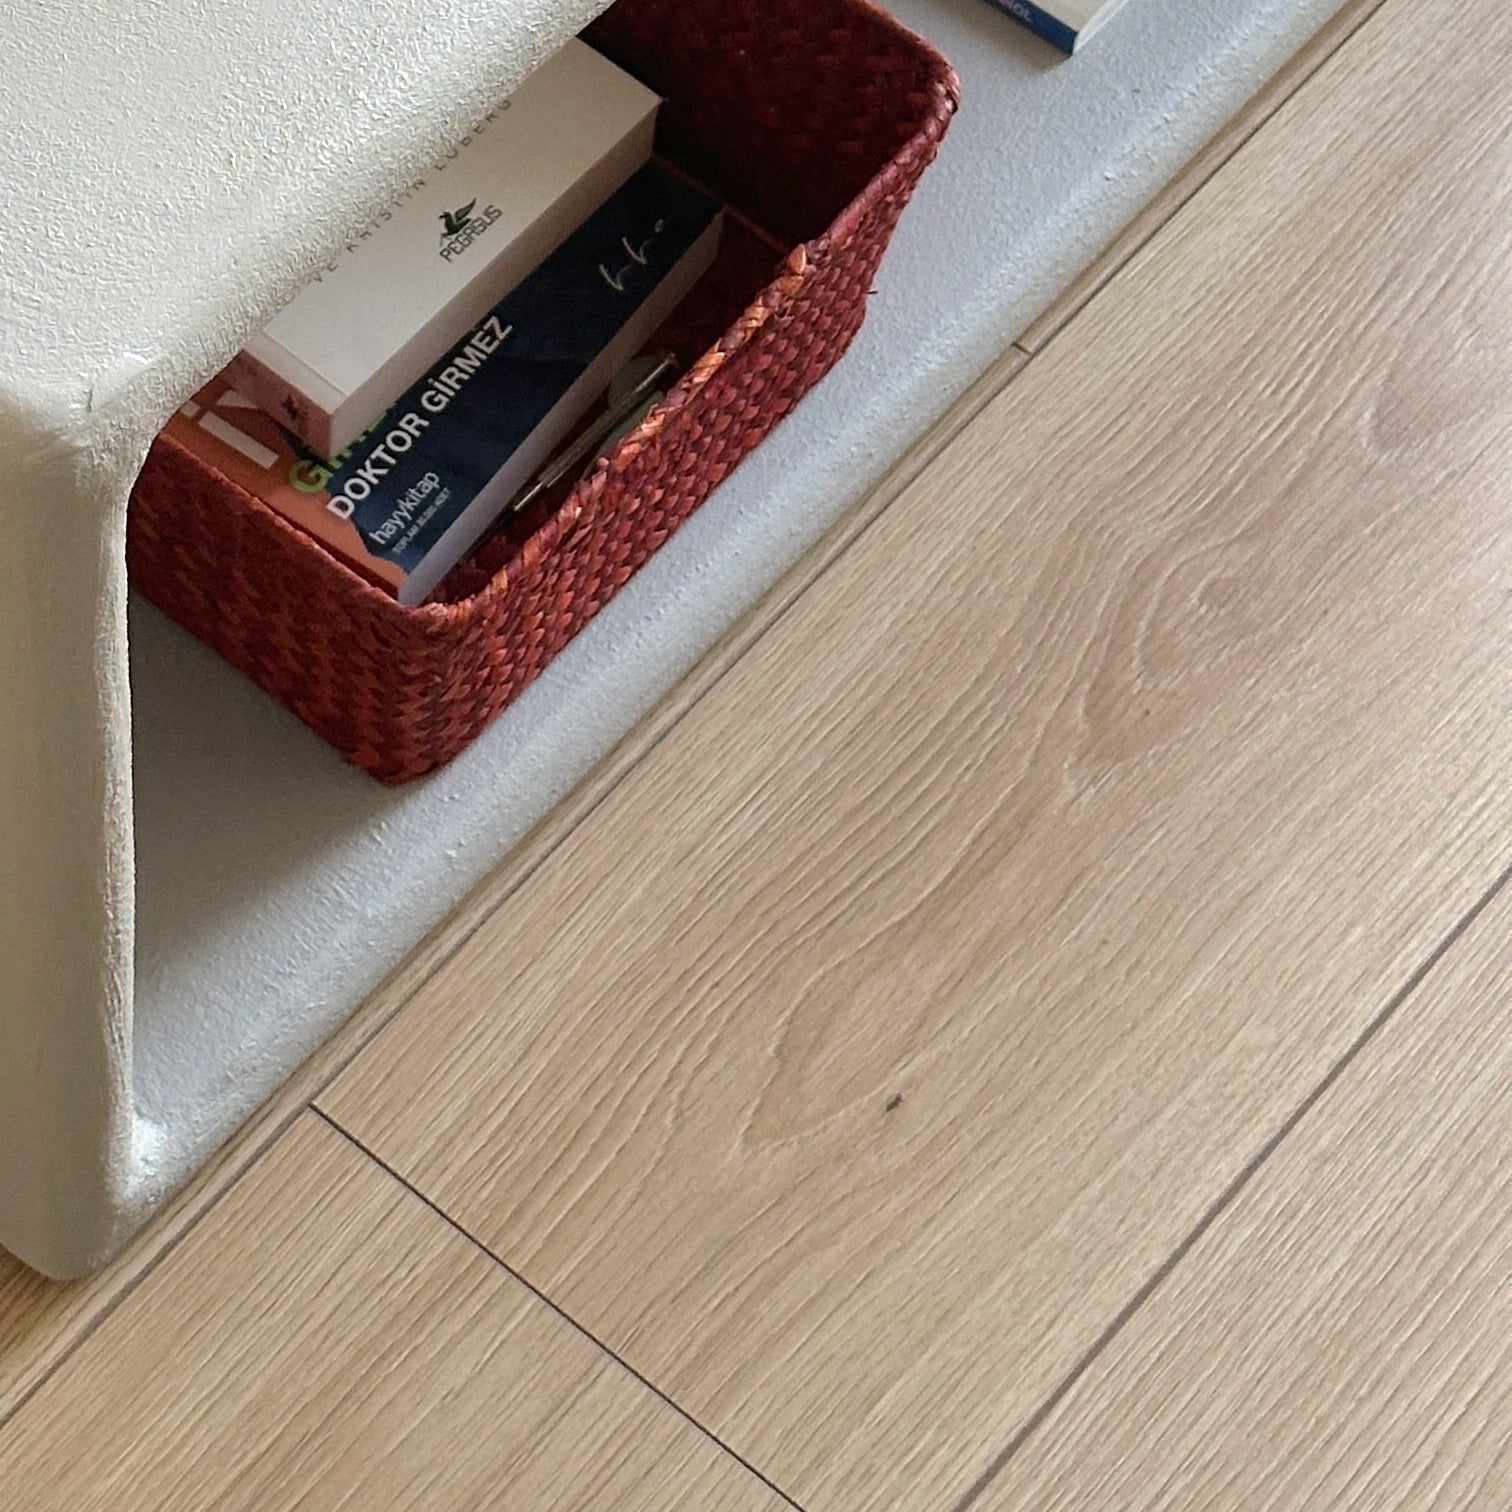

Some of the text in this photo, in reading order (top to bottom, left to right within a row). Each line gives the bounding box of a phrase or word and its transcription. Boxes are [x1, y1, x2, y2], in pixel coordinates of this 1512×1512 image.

[440, 204, 503, 263] PEGASUS
[326, 412, 430, 520] DOKTOR
[420, 315, 513, 413] GİRMEZ
[369, 472, 440, 545] hayykitap
